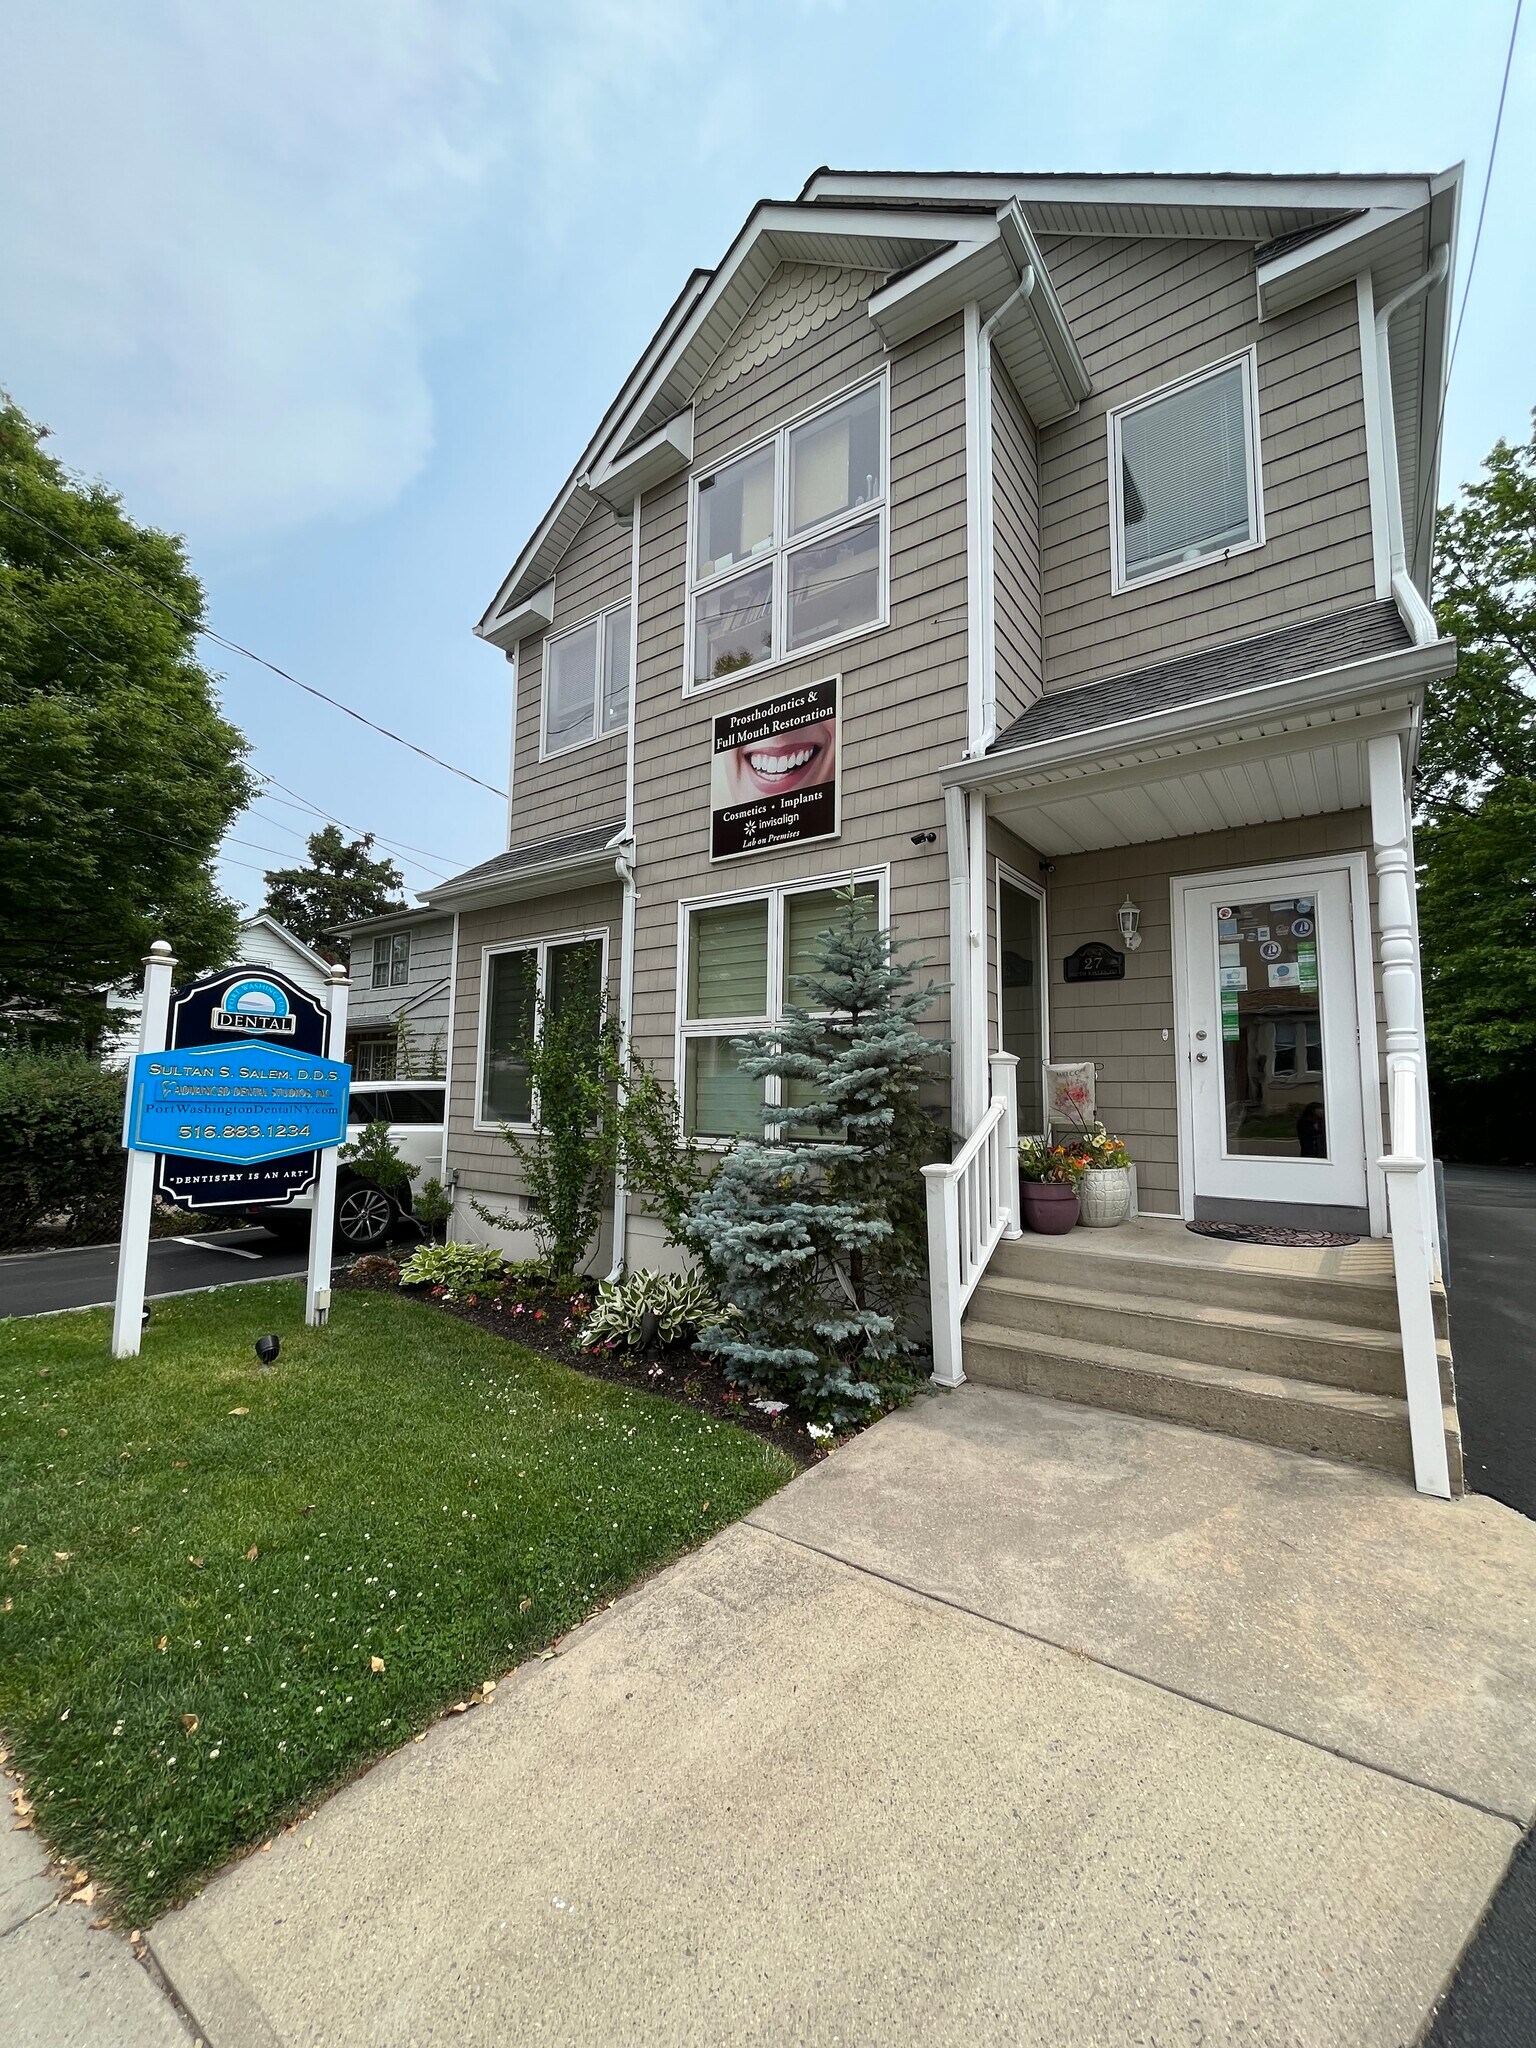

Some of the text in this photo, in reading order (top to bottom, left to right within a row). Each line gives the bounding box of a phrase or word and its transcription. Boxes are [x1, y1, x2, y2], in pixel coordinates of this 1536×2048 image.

[730, 690, 818, 728] Prosthodontics &
[716, 706, 834, 750] Full Mouth Restoration
[723, 791, 823, 822] Cosmetics Implants
[759, 812, 800, 829] invisalign
[742, 830, 800, 848] Lab on Premises
[1084, 957, 1103, 970] 27
[227, 982, 285, 1014] PORT WASHINGTON
[220, 1013, 290, 1030] DENTAL
[149, 1063, 214, 1077] SULTAN
[219, 1066, 234, 1078] S.
[297, 1069, 341, 1081] D.D.S.
[174, 1085, 231, 1097] ADVANCED
[233, 1086, 268, 1097] DENTAL
[145, 1103, 338, 1117] PortWashingtonDentalNY.com
[178, 1124, 311, 1139] 516.883.1234
[248, 1172, 259, 1180] IS
[264, 1171, 279, 1180] AN
